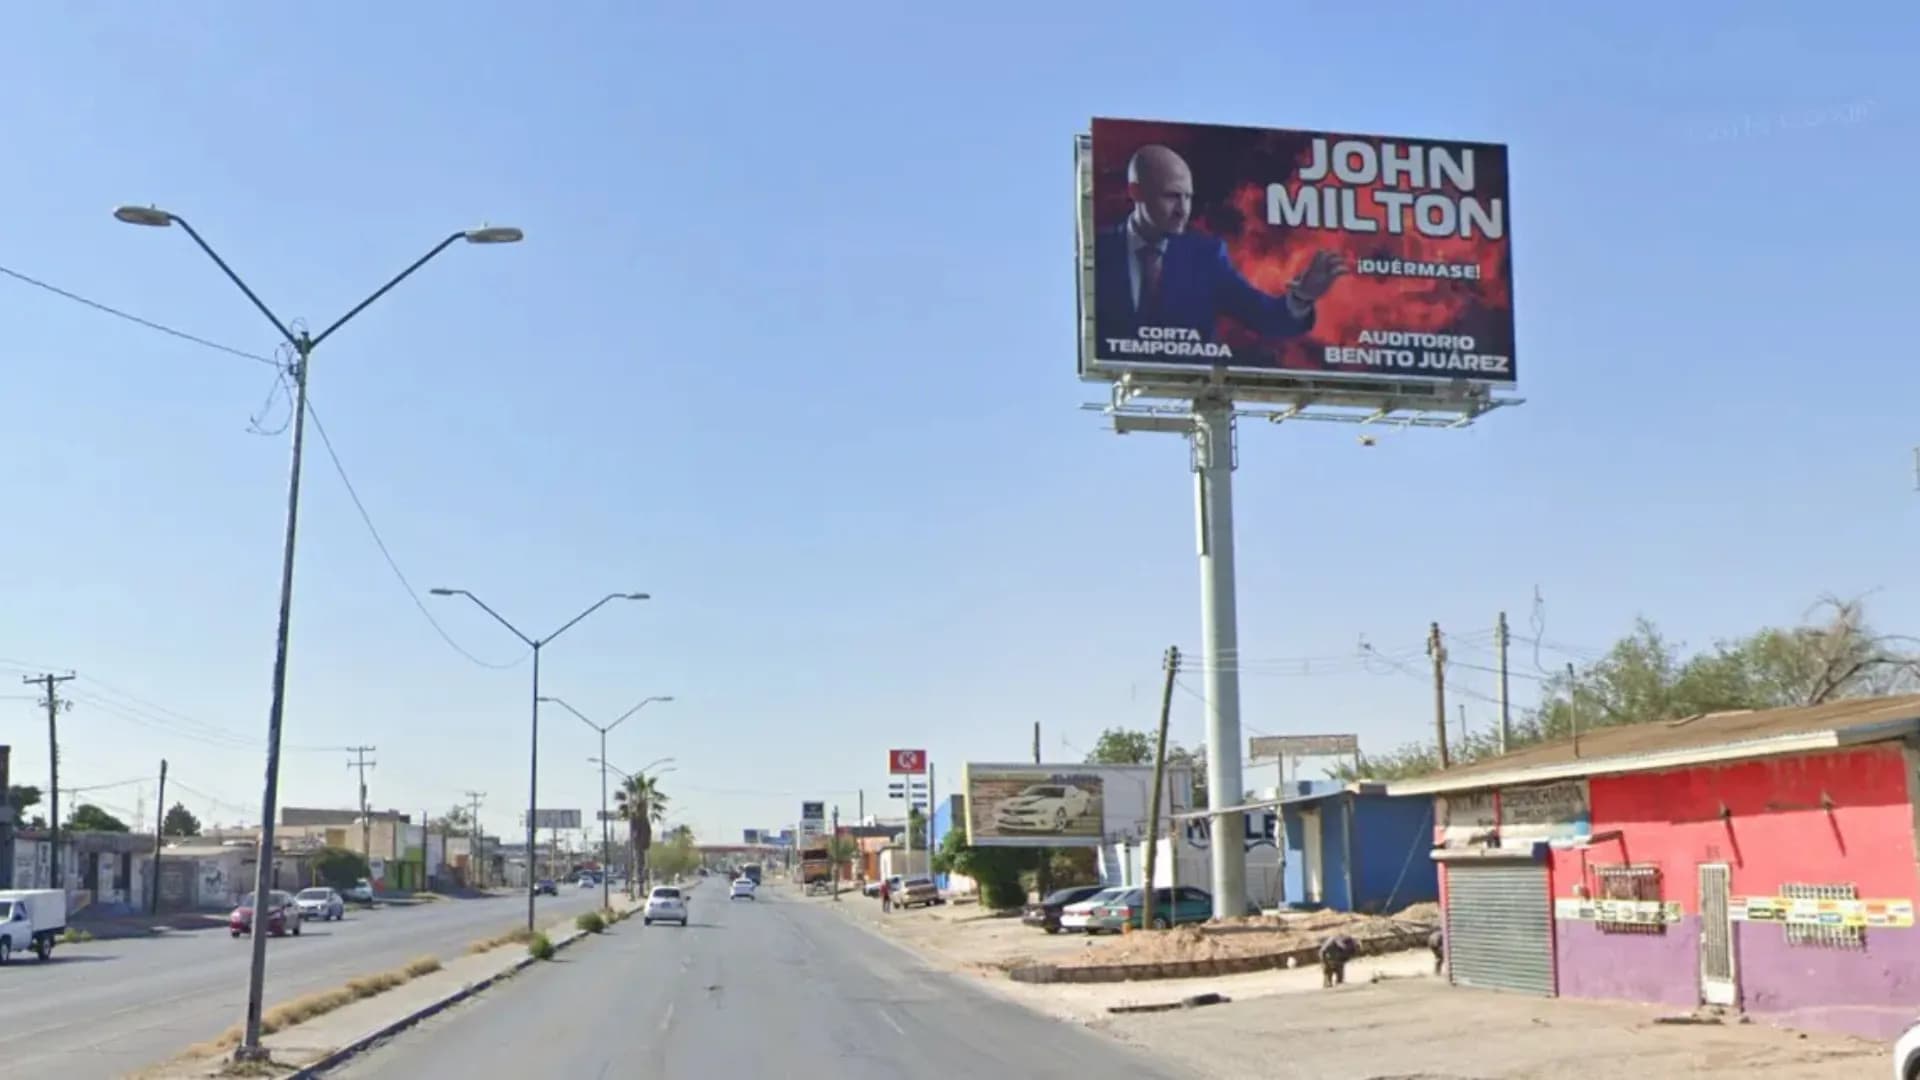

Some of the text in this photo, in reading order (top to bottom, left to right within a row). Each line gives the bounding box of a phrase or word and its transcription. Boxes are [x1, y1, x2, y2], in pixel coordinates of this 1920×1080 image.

[1298, 138, 1475, 191] JOHN
[1266, 183, 1503, 238] MILTON
[1357, 258, 1480, 280] ¡DUÉRMASE!
[1138, 326, 1200, 341] CORTA
[1358, 329, 1475, 351] AUDITORIO
[1106, 338, 1232, 358] TEMPORADA
[1324, 346, 1509, 372] BENITO JUÁREZ
